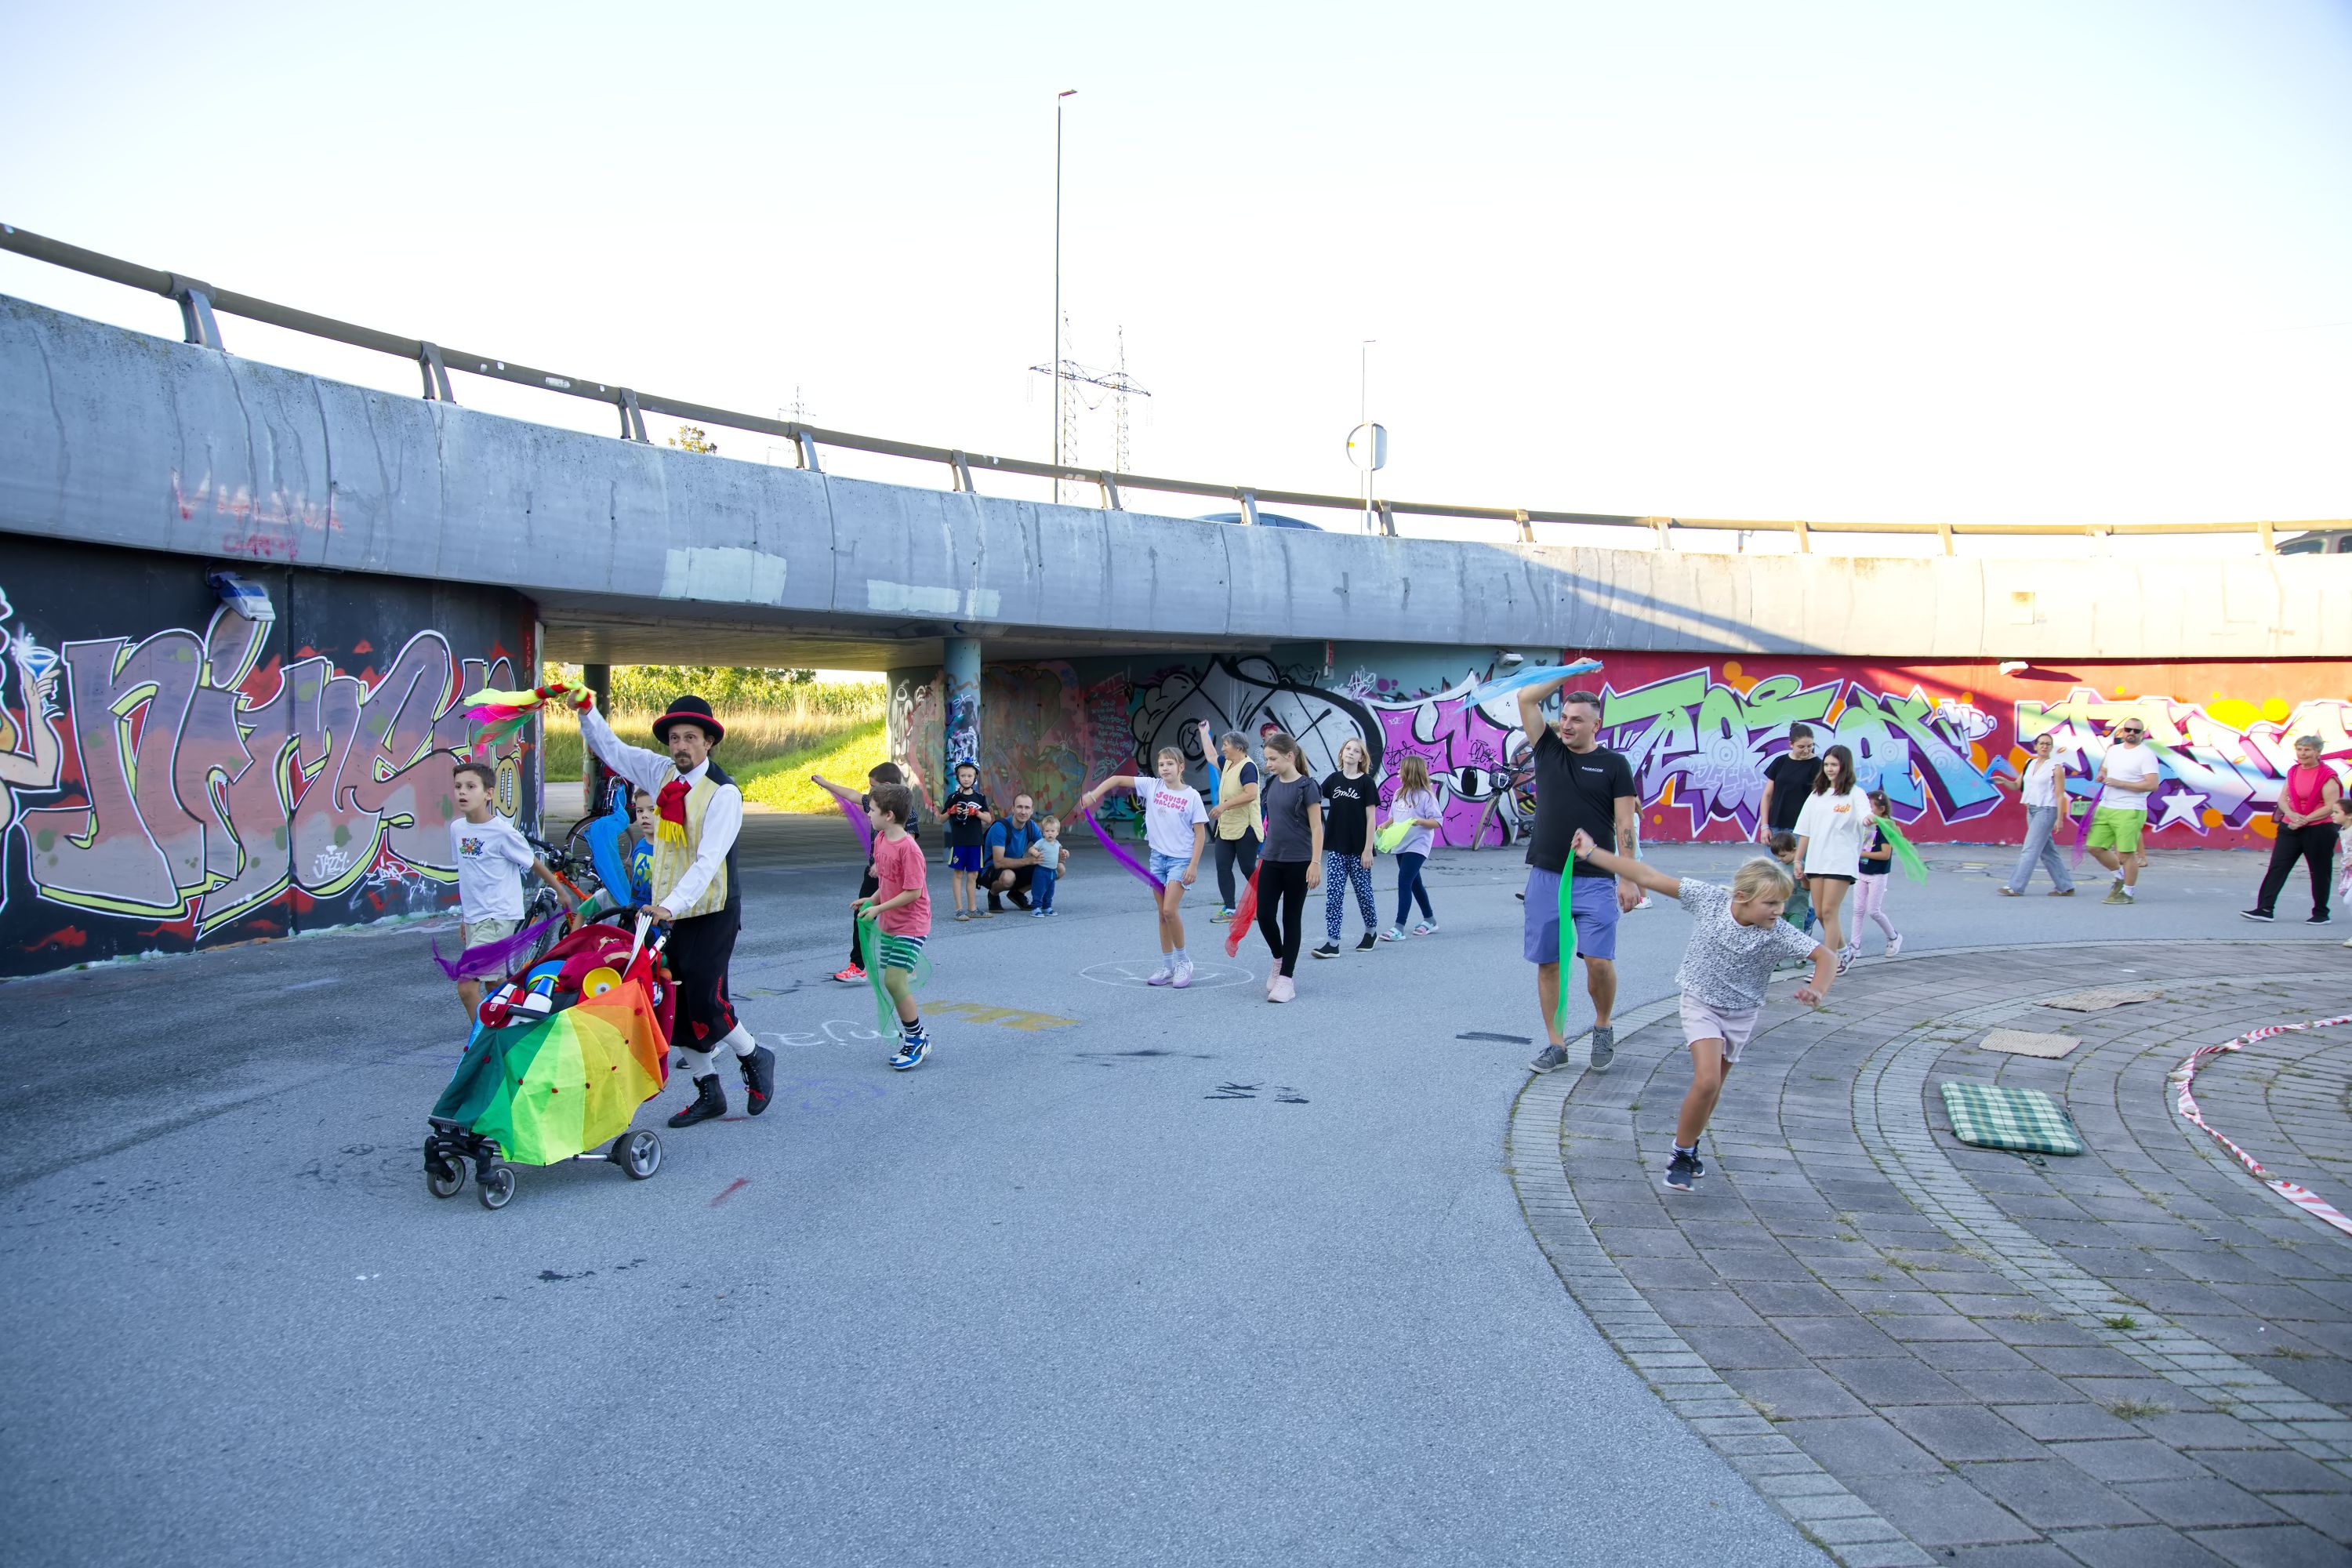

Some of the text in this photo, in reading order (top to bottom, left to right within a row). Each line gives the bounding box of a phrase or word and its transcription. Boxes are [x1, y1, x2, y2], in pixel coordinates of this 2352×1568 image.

[1156, 791, 1189, 806] SQUISH
[1332, 786, 1361, 800] Smile
[1153, 798, 1185, 812] MALLOWS
[313, 851, 348, 879] JAZZY
